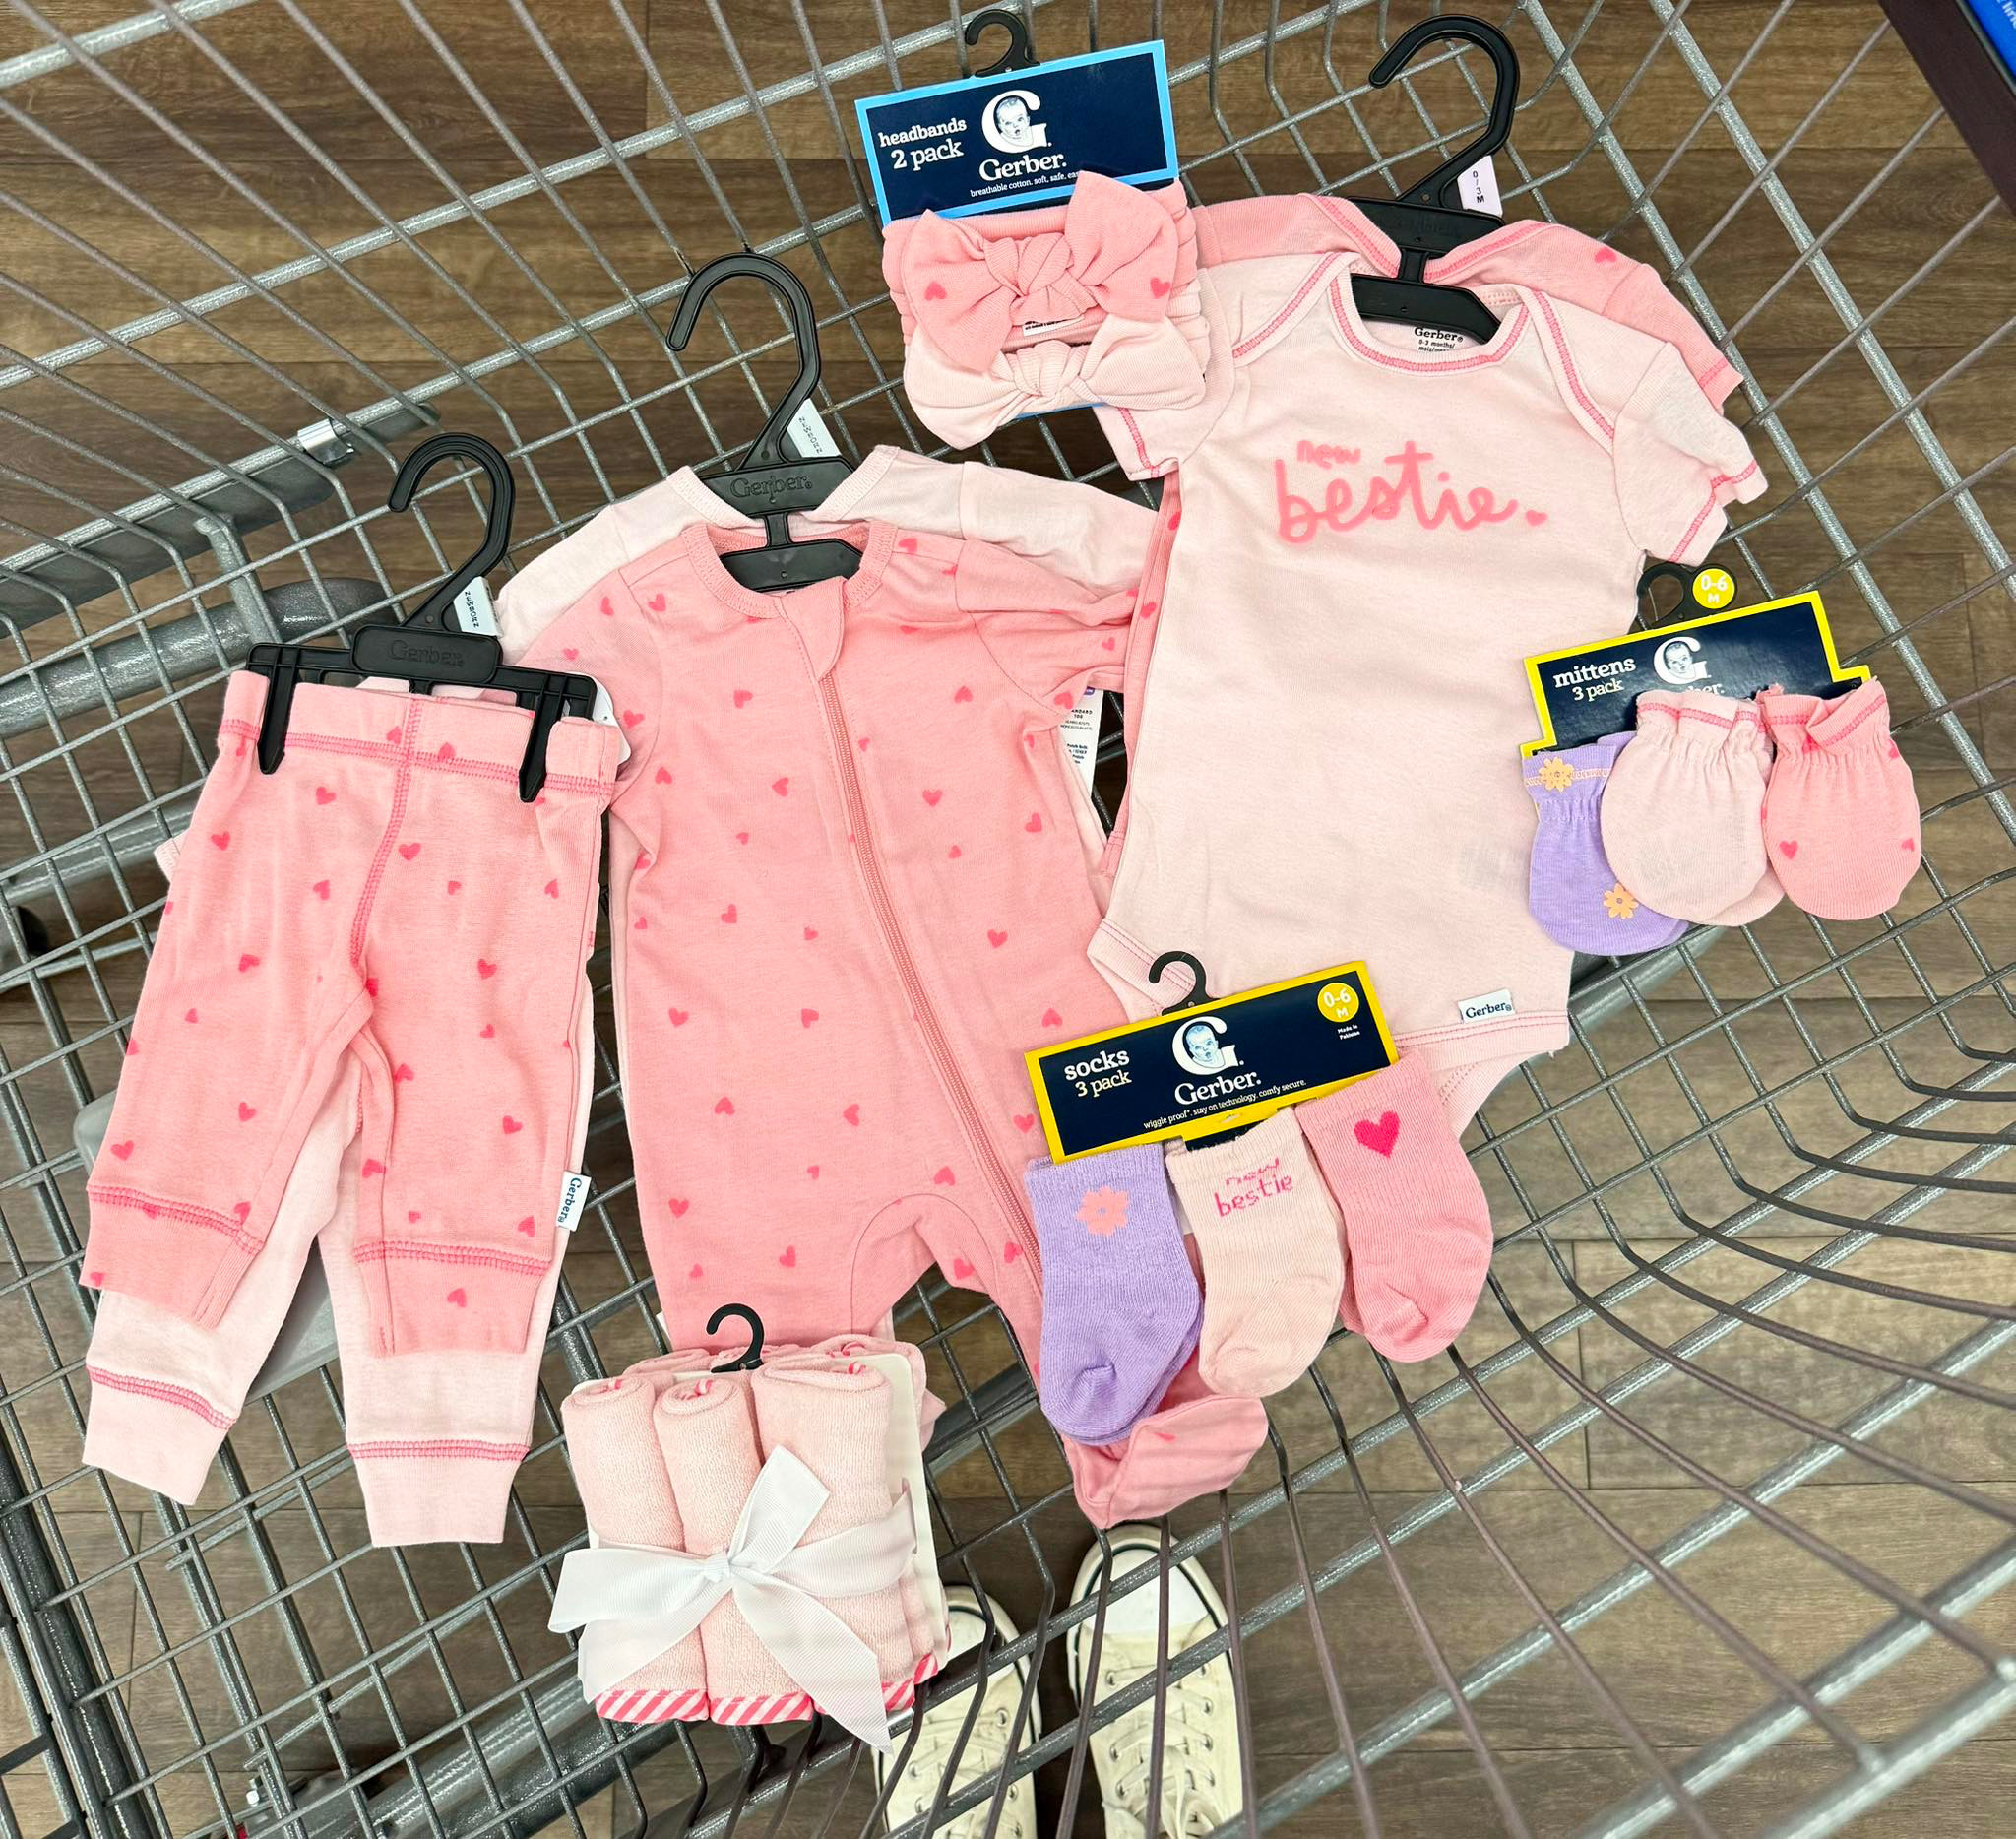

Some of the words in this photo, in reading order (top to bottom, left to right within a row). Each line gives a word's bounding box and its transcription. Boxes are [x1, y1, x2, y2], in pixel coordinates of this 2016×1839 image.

[877, 117, 968, 148] headbands
[890, 149, 908, 169] 2
[910, 138, 965, 171] pack
[970, 181, 1008, 197] breathable
[1296, 439, 1361, 470] new
[1700, 574, 1729, 592] 0-6
[1707, 592, 1720, 603] M
[464, 590, 480, 628] NEWBORN
[1552, 657, 1637, 688] mittens
[1571, 686, 1585, 701] 3
[1585, 678, 1625, 702] pack
[1323, 987, 1352, 1008] 0-6
[1336, 1006, 1349, 1019] M
[1064, 1050, 1130, 1081] socks
[1075, 1081, 1088, 1097] 3
[1090, 1069, 1132, 1098] pack
[1143, 1116, 1167, 1129] wiggle
[1193, 1105, 1208, 1115] stay
[1258, 1085, 1281, 1098] comfy
[1214, 1174, 1292, 1218] bestie
